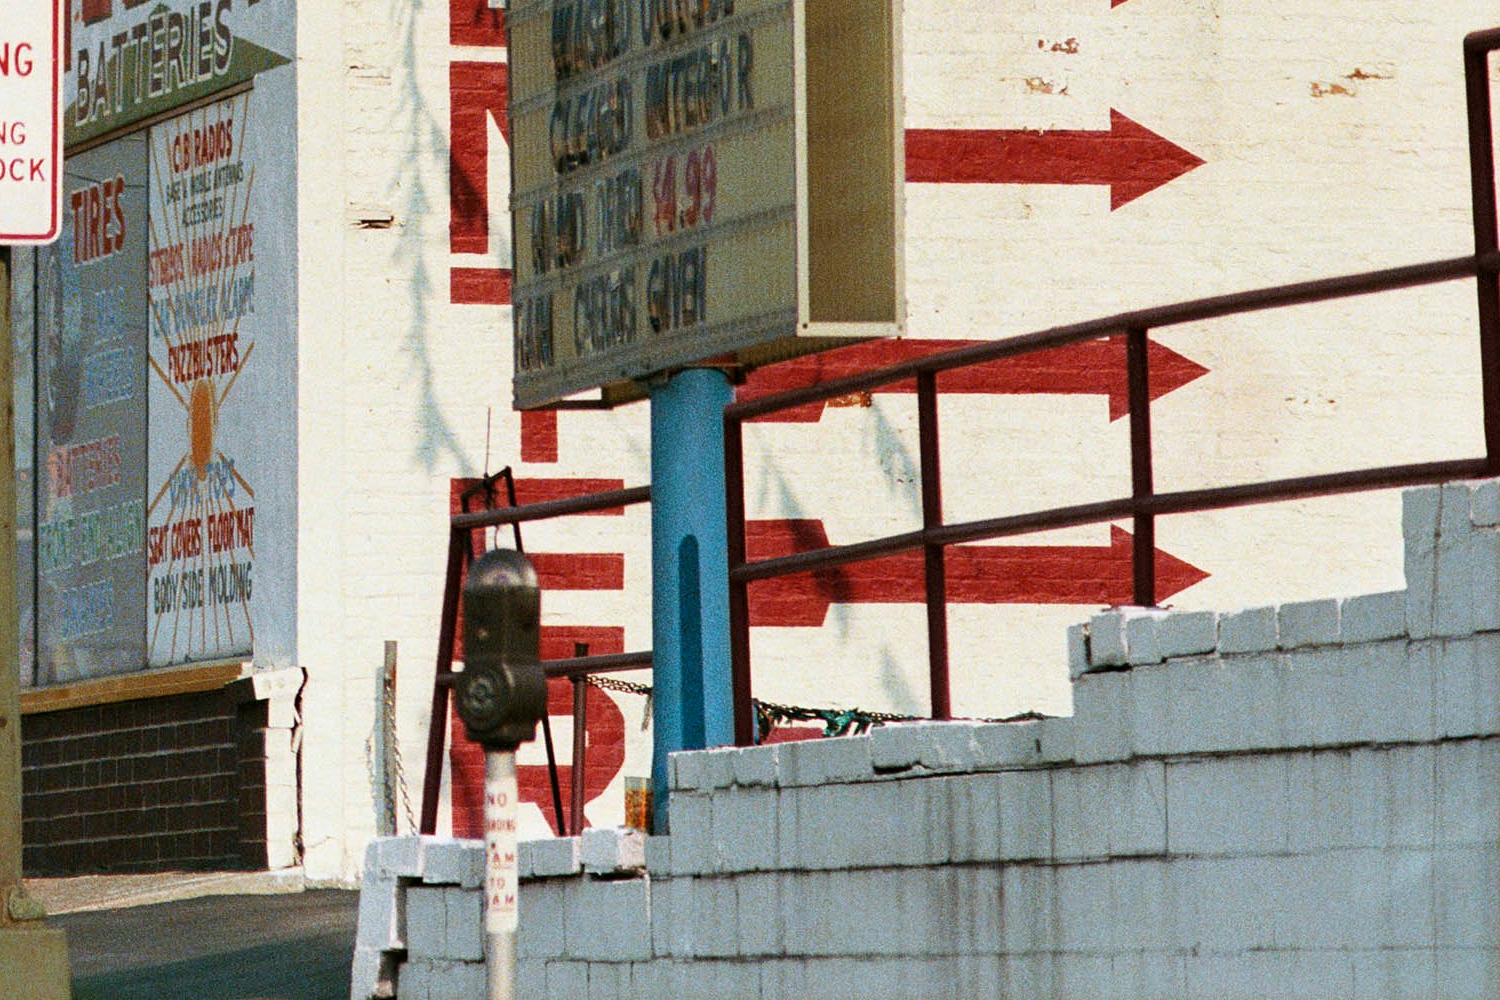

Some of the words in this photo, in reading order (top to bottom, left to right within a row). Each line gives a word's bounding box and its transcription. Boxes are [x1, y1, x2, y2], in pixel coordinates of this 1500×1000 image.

[194, 118, 233, 168] RADIOS
[71, 175, 126, 266] TIRES
[169, 332, 239, 384] FUZZBUSTERS
[154, 573, 180, 614] BODY
[182, 568, 204, 610] SIDE
[208, 561, 253, 606] MOLDING
[486, 792, 508, 808] NO
